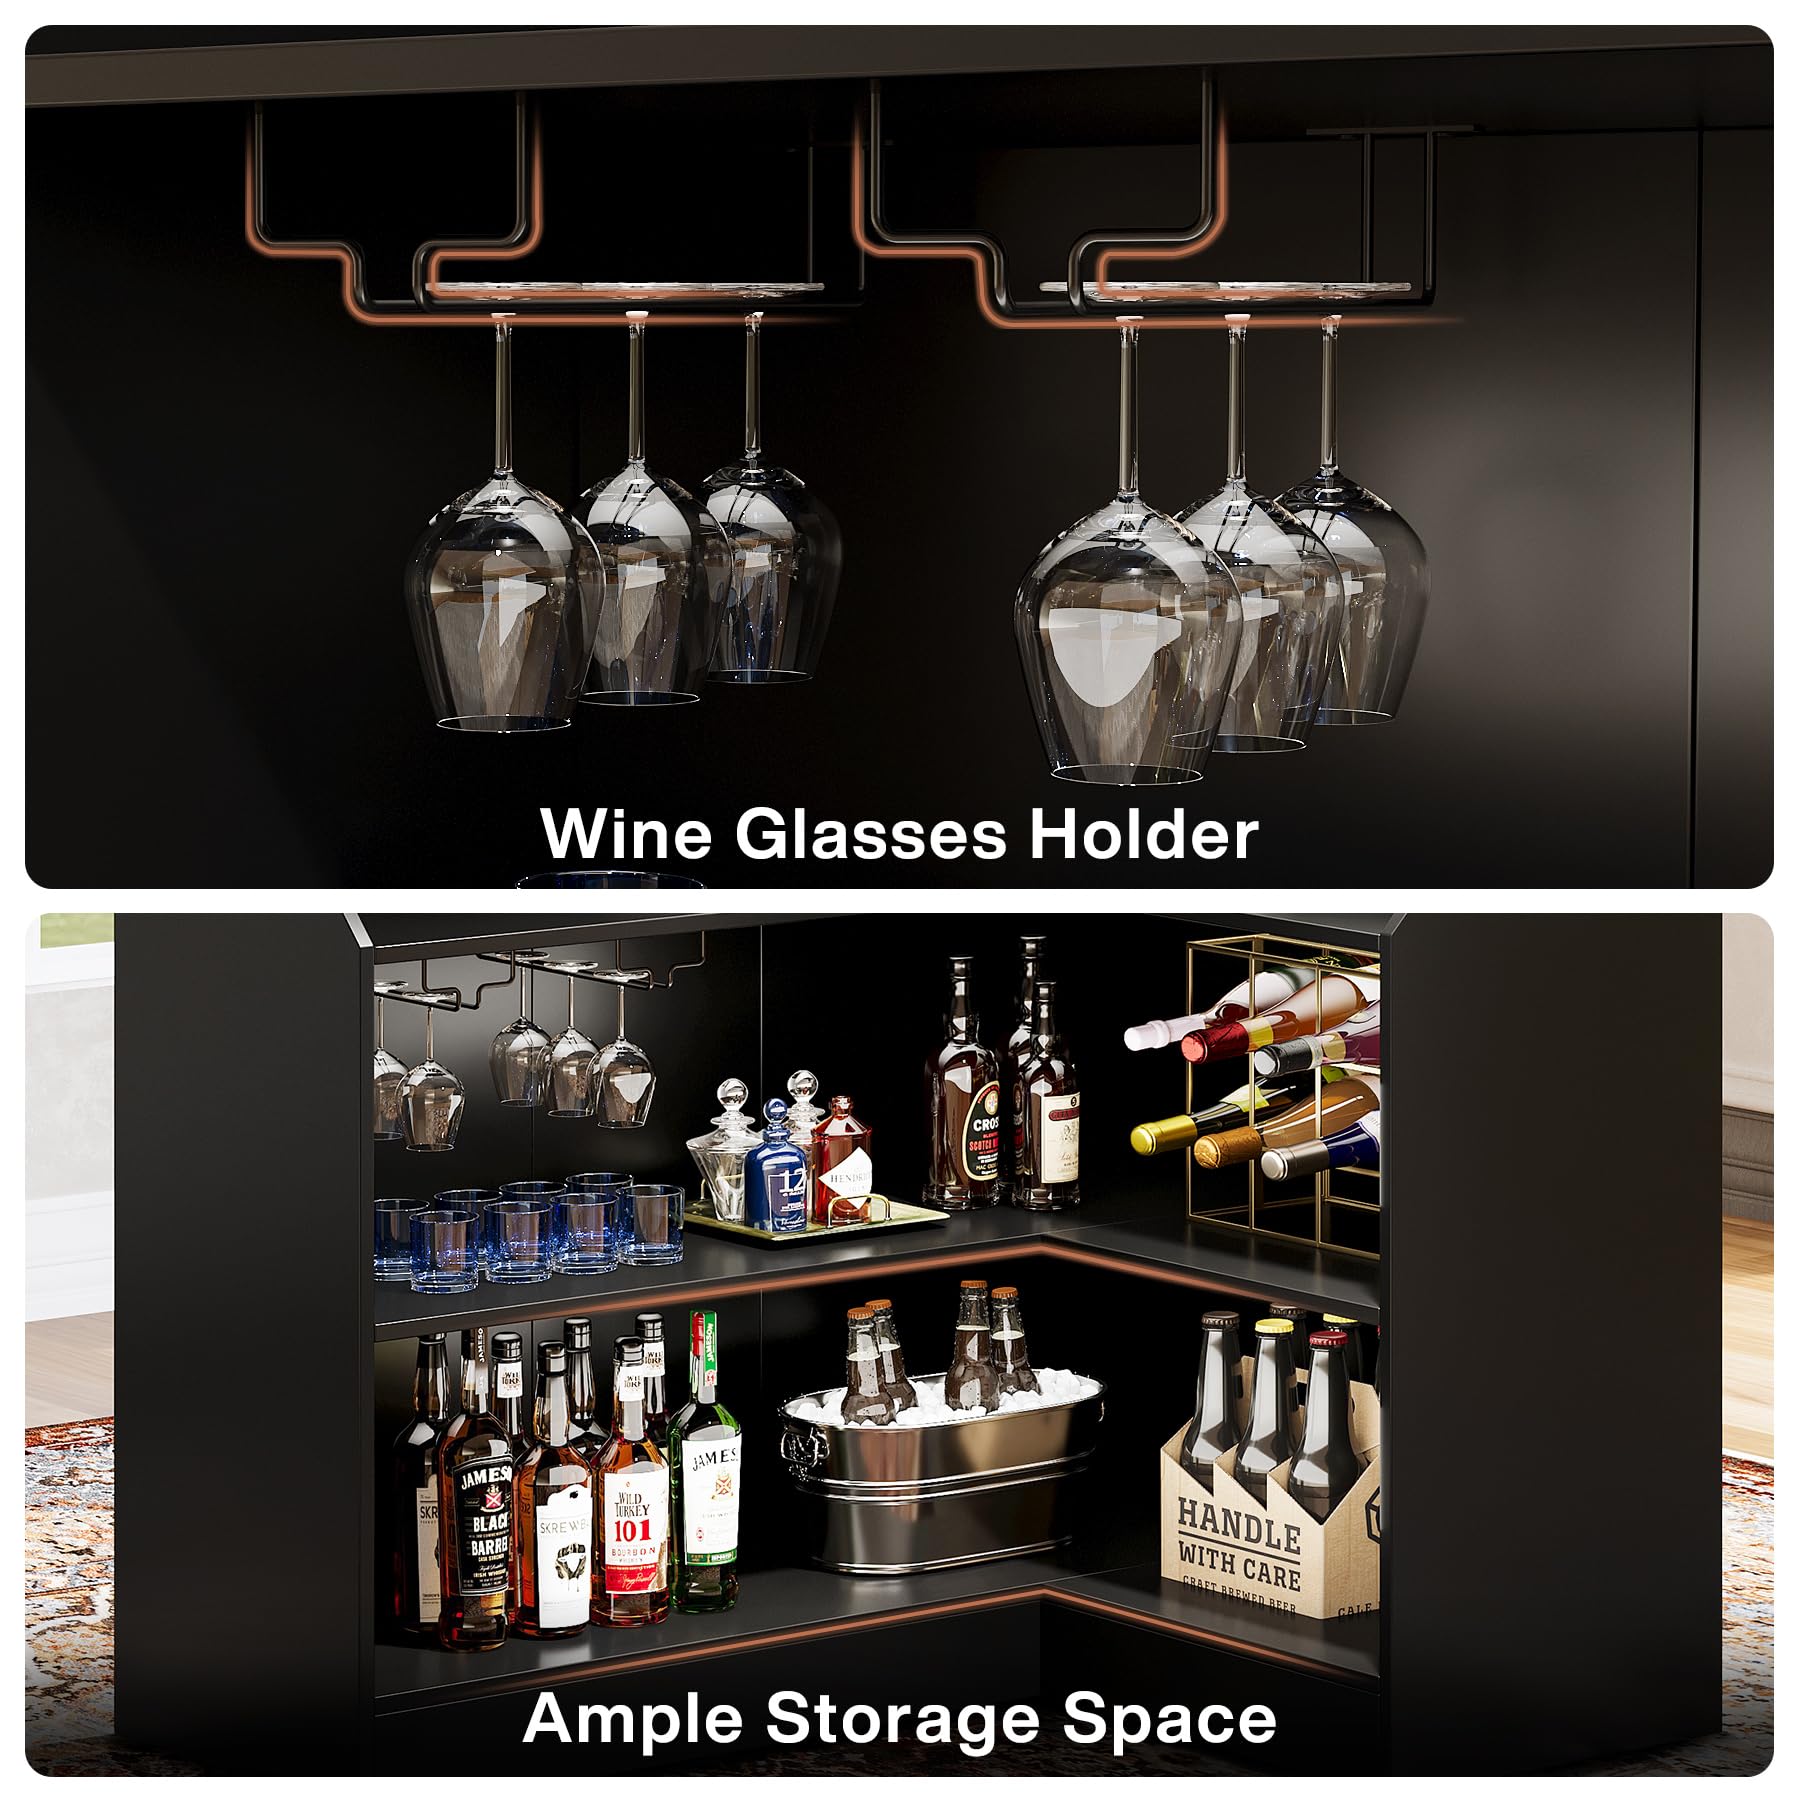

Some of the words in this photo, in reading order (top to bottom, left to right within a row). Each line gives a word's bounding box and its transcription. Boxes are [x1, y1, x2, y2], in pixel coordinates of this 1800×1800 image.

[706, 1323, 714, 1362] JAMESON
[615, 1503, 650, 1518] TURKEY
[619, 1491, 642, 1505] WILD
[615, 1519, 651, 1542] 101
[1178, 1496, 1300, 1555] HANDLE
[611, 1547, 656, 1557] BOURBON
[1178, 1540, 1235, 1575] WITH
[1243, 1558, 1300, 1592] CARE
[1183, 1575, 1217, 1591] CRAFT
[1221, 1585, 1265, 1605] BREWED
[1270, 1598, 1297, 1613] BEER
